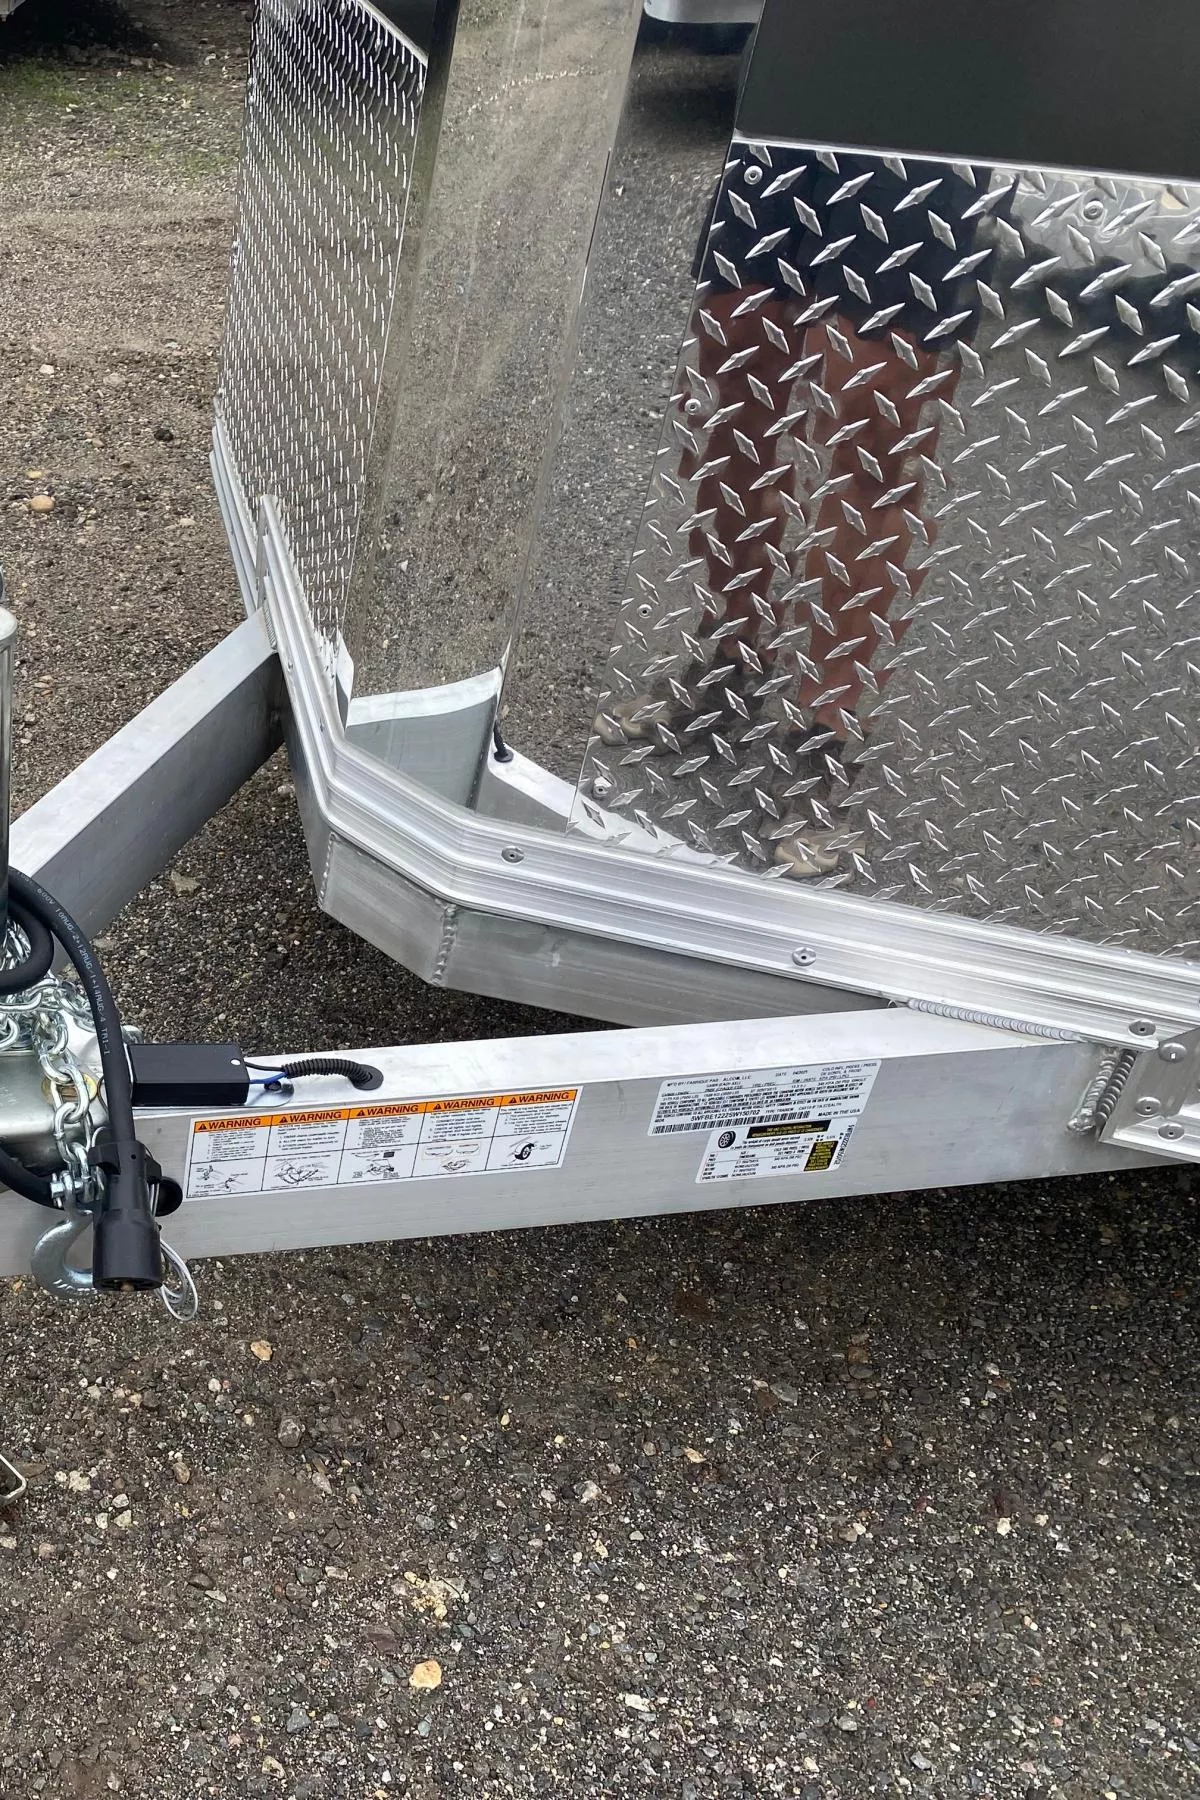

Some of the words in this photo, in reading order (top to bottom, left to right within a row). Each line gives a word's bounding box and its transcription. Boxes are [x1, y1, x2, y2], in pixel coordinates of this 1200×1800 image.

[518, 1091, 569, 1103] WARNING
[367, 1104, 419, 1116] WARNING
[443, 1098, 495, 1110] WARNING
[289, 1111, 342, 1123] WARNING
[209, 1118, 261, 1130] WARNING
